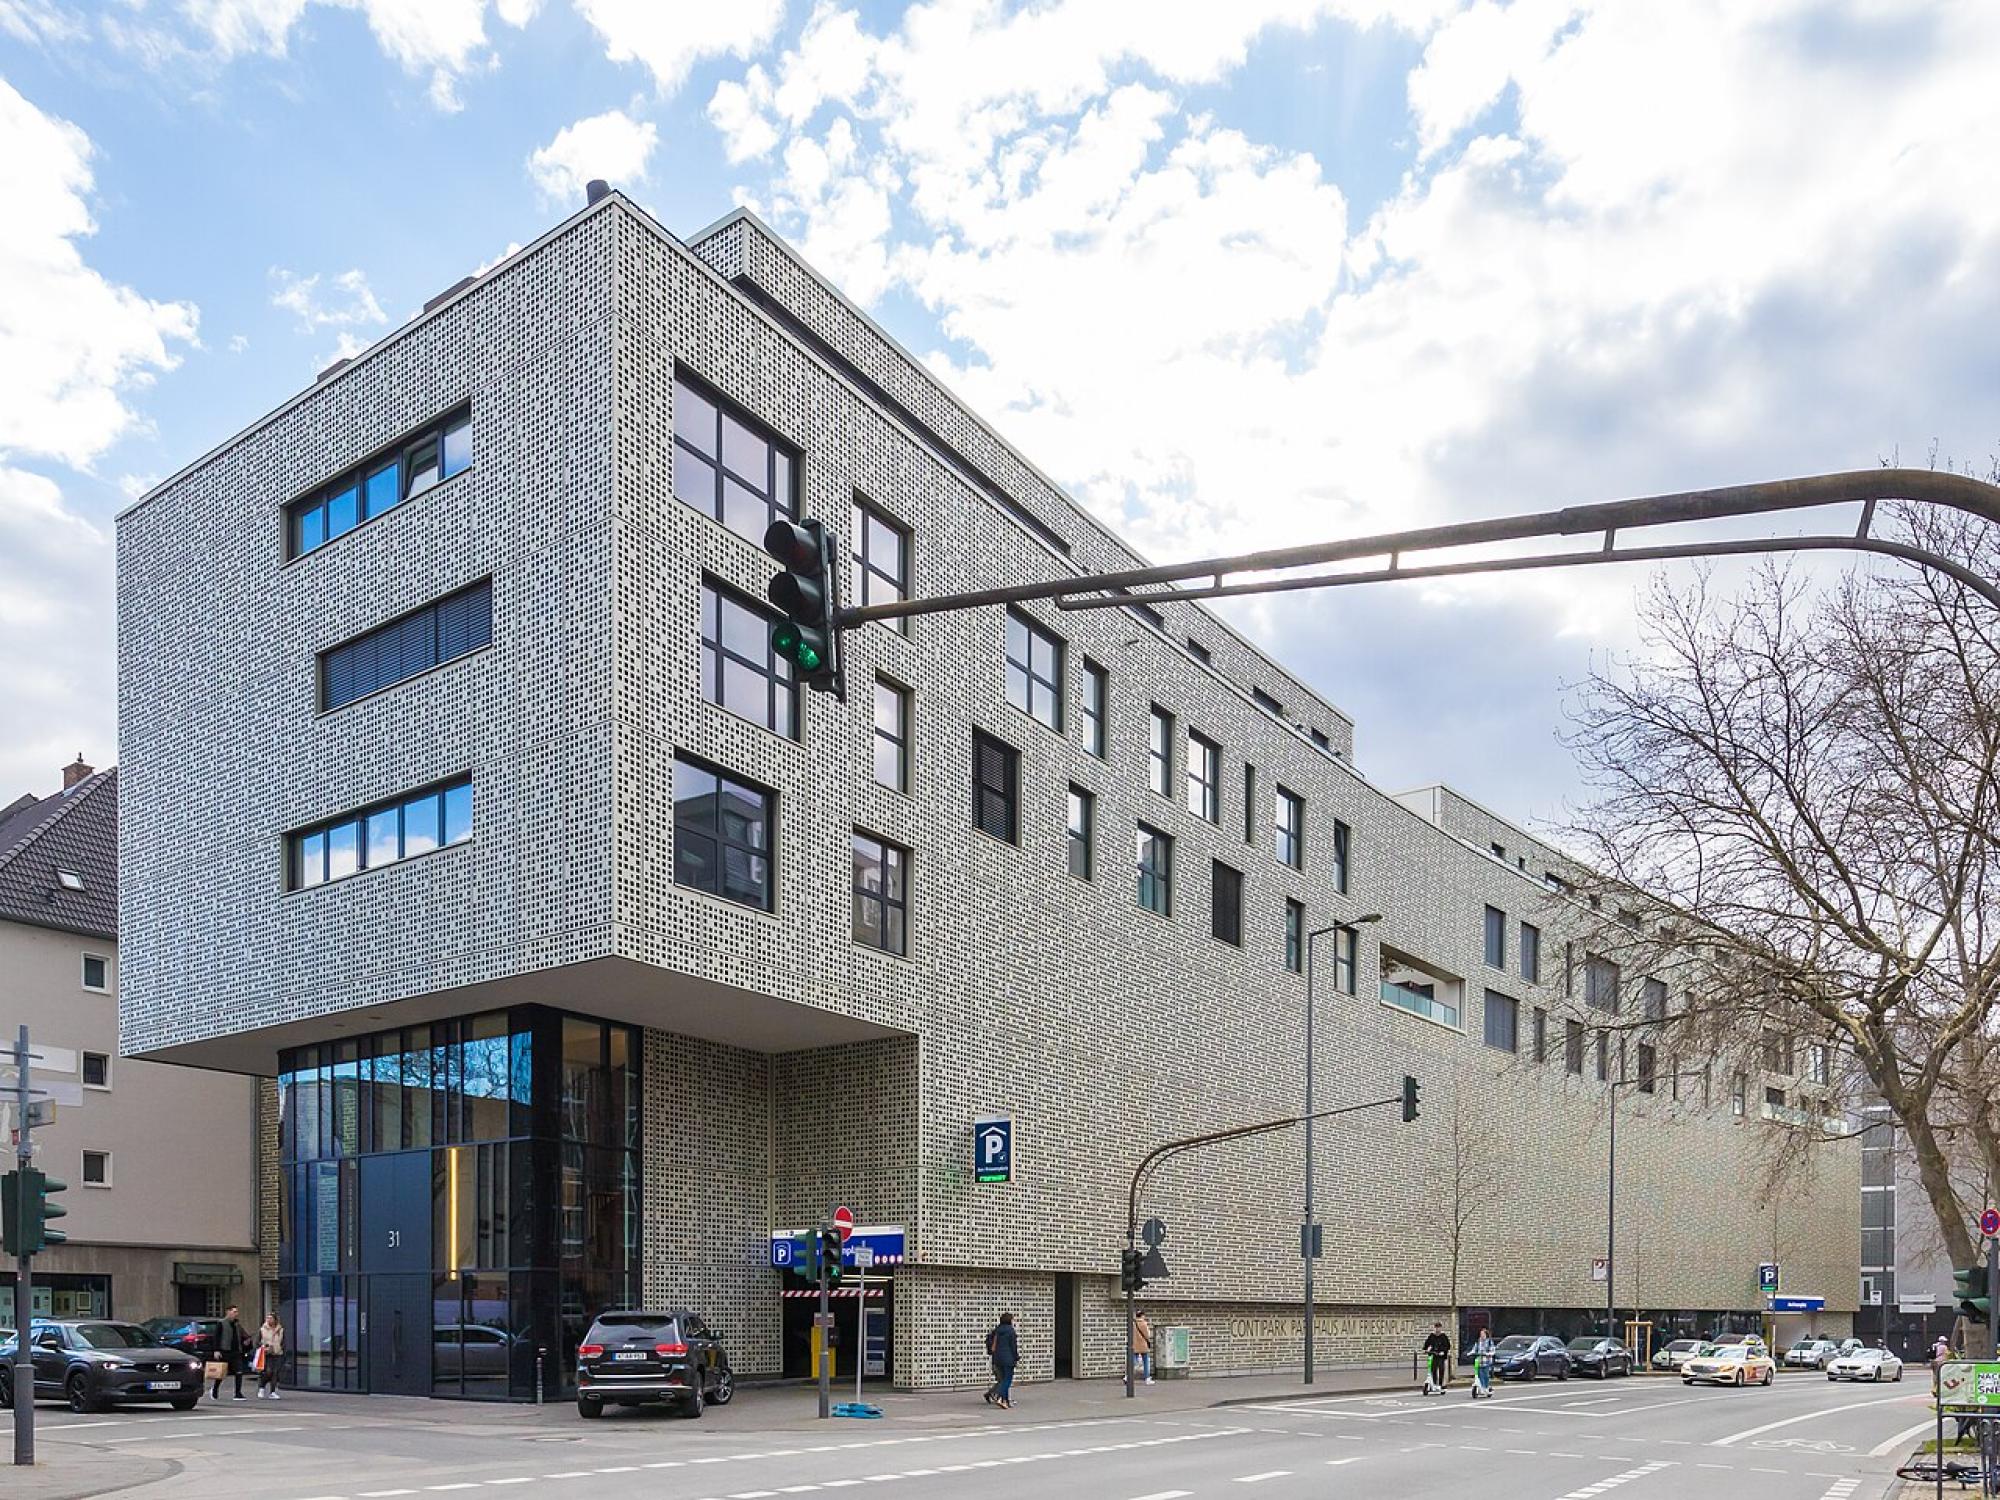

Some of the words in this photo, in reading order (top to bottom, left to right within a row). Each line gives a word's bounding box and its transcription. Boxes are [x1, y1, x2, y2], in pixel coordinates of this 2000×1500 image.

[985, 1135, 1003, 1164] P
[388, 1230, 400, 1248] 31
[777, 1249, 787, 1262] P
[1765, 1271, 1774, 1283] P
[1231, 1319, 1287, 1337] CONTIPARK
[1290, 1318, 1338, 1337] PAHAUS
[1342, 1318, 1356, 1336] AM
